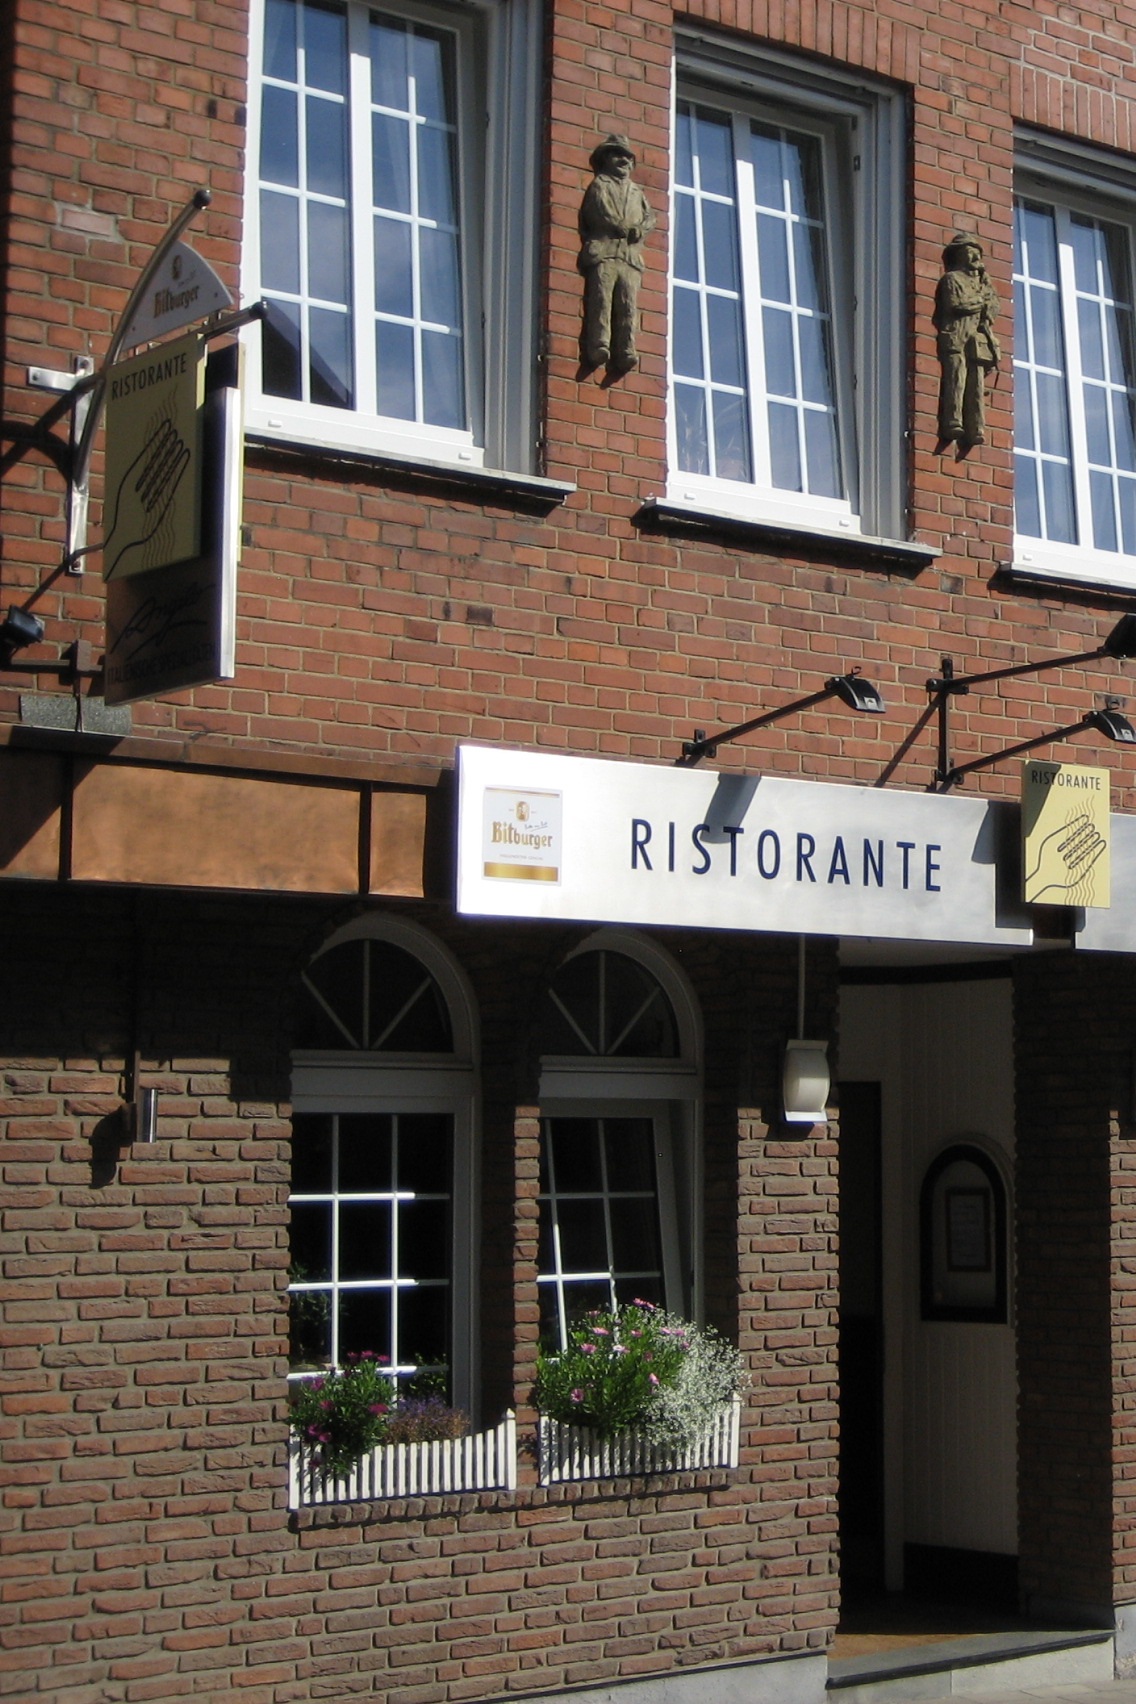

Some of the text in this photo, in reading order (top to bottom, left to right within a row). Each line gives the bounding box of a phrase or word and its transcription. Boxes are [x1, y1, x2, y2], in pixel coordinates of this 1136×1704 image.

[112, 353, 187, 400] RISTORANTE
[1031, 770, 1101, 791] RISTORANTE
[490, 820, 553, 850] Bitburger
[631, 818, 942, 892] RISTORANTE
